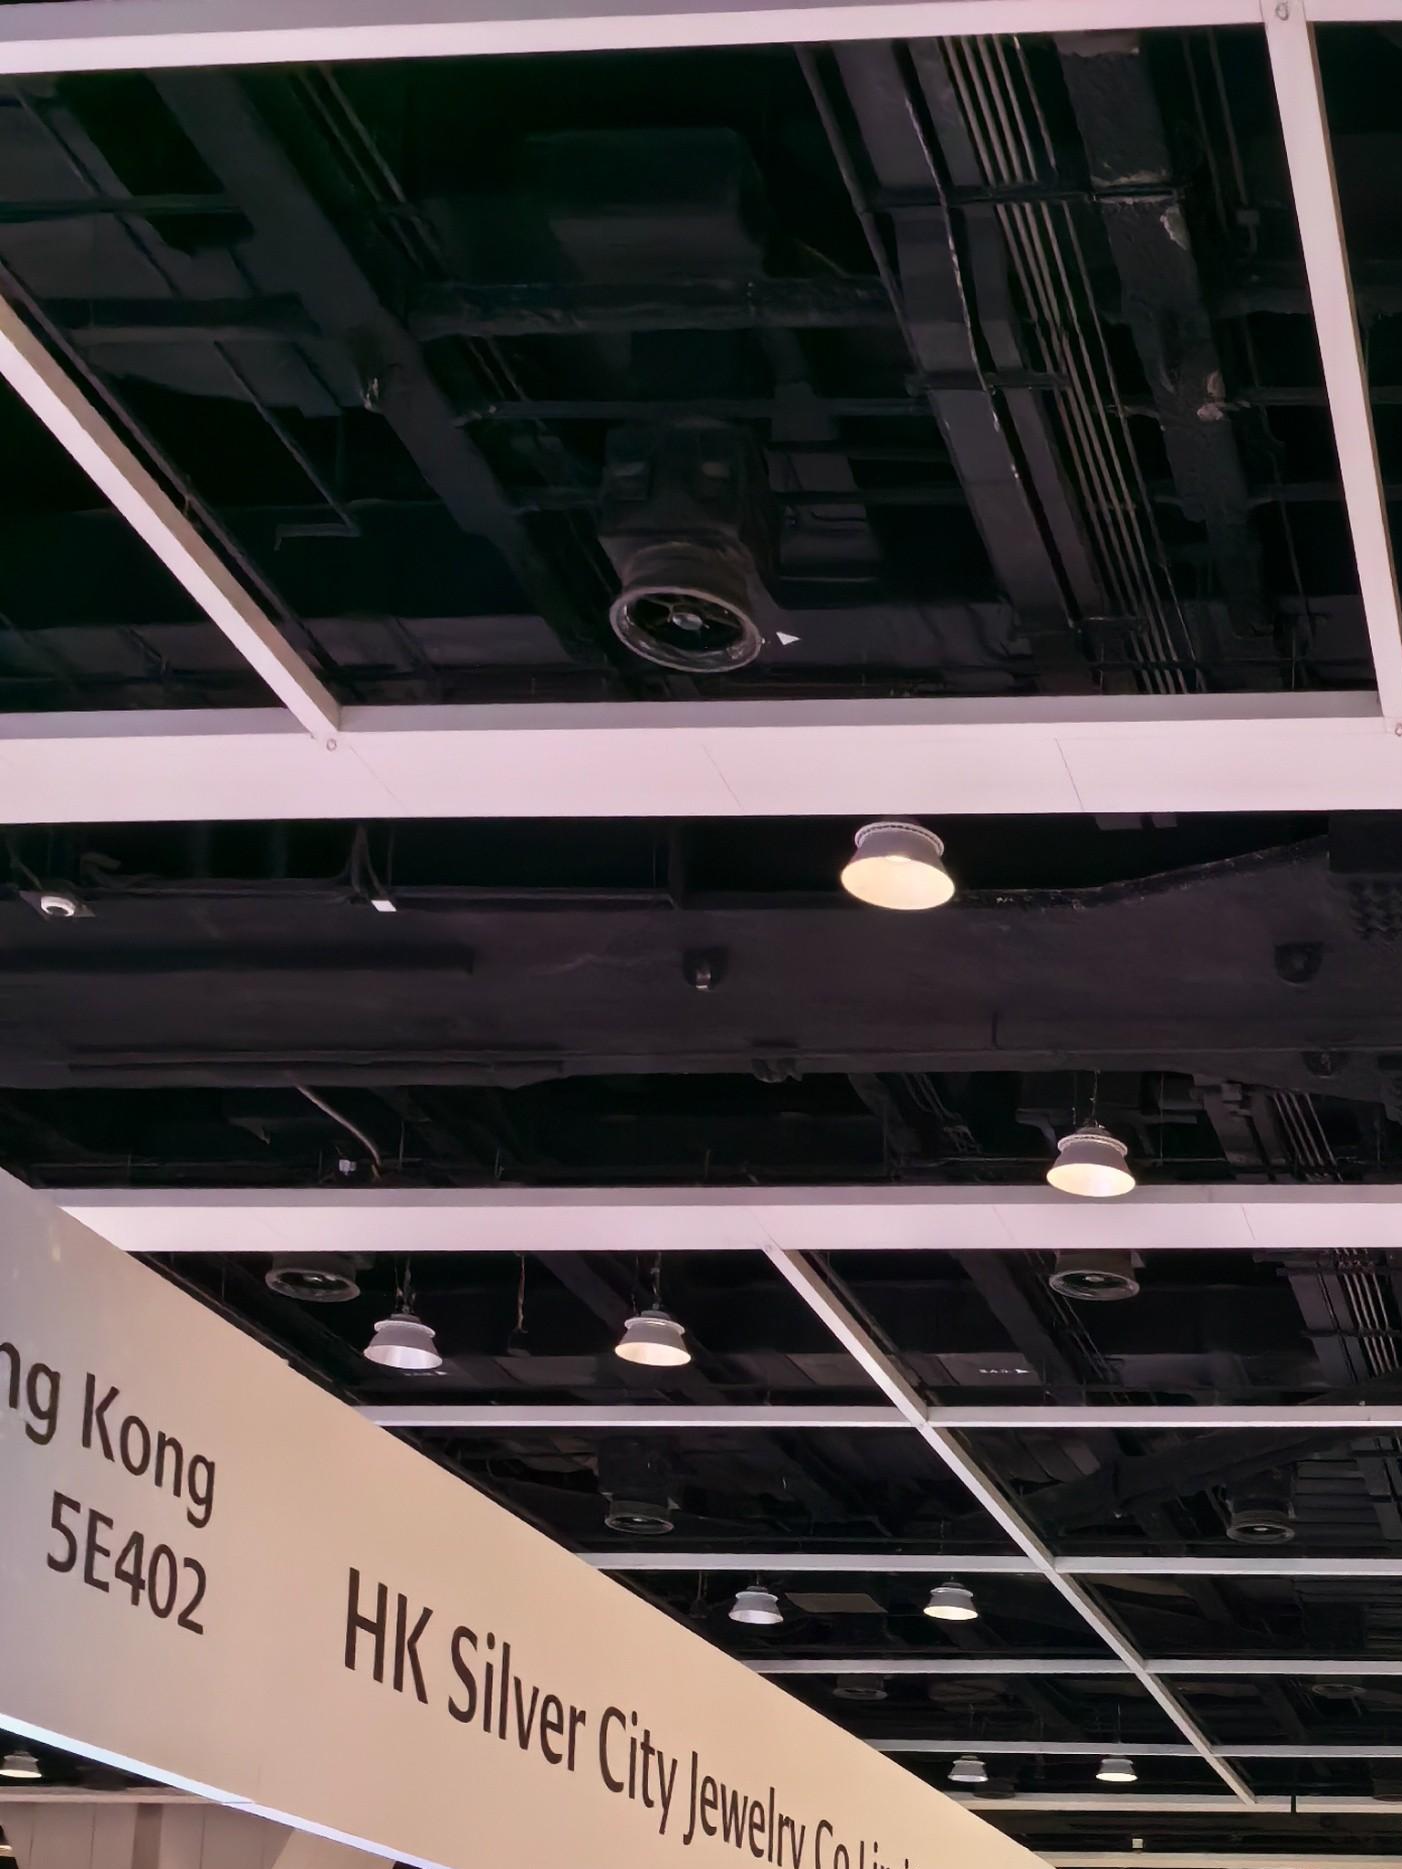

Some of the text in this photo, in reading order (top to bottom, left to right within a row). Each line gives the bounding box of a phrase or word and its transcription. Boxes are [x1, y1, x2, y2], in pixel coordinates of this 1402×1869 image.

[0, 1342, 215, 1528] ng Kong
[47, 1490, 206, 1635] 5E402
[345, 1567, 433, 1704] HK
[448, 1626, 586, 1771] Silver
[599, 1706, 677, 1835] City
